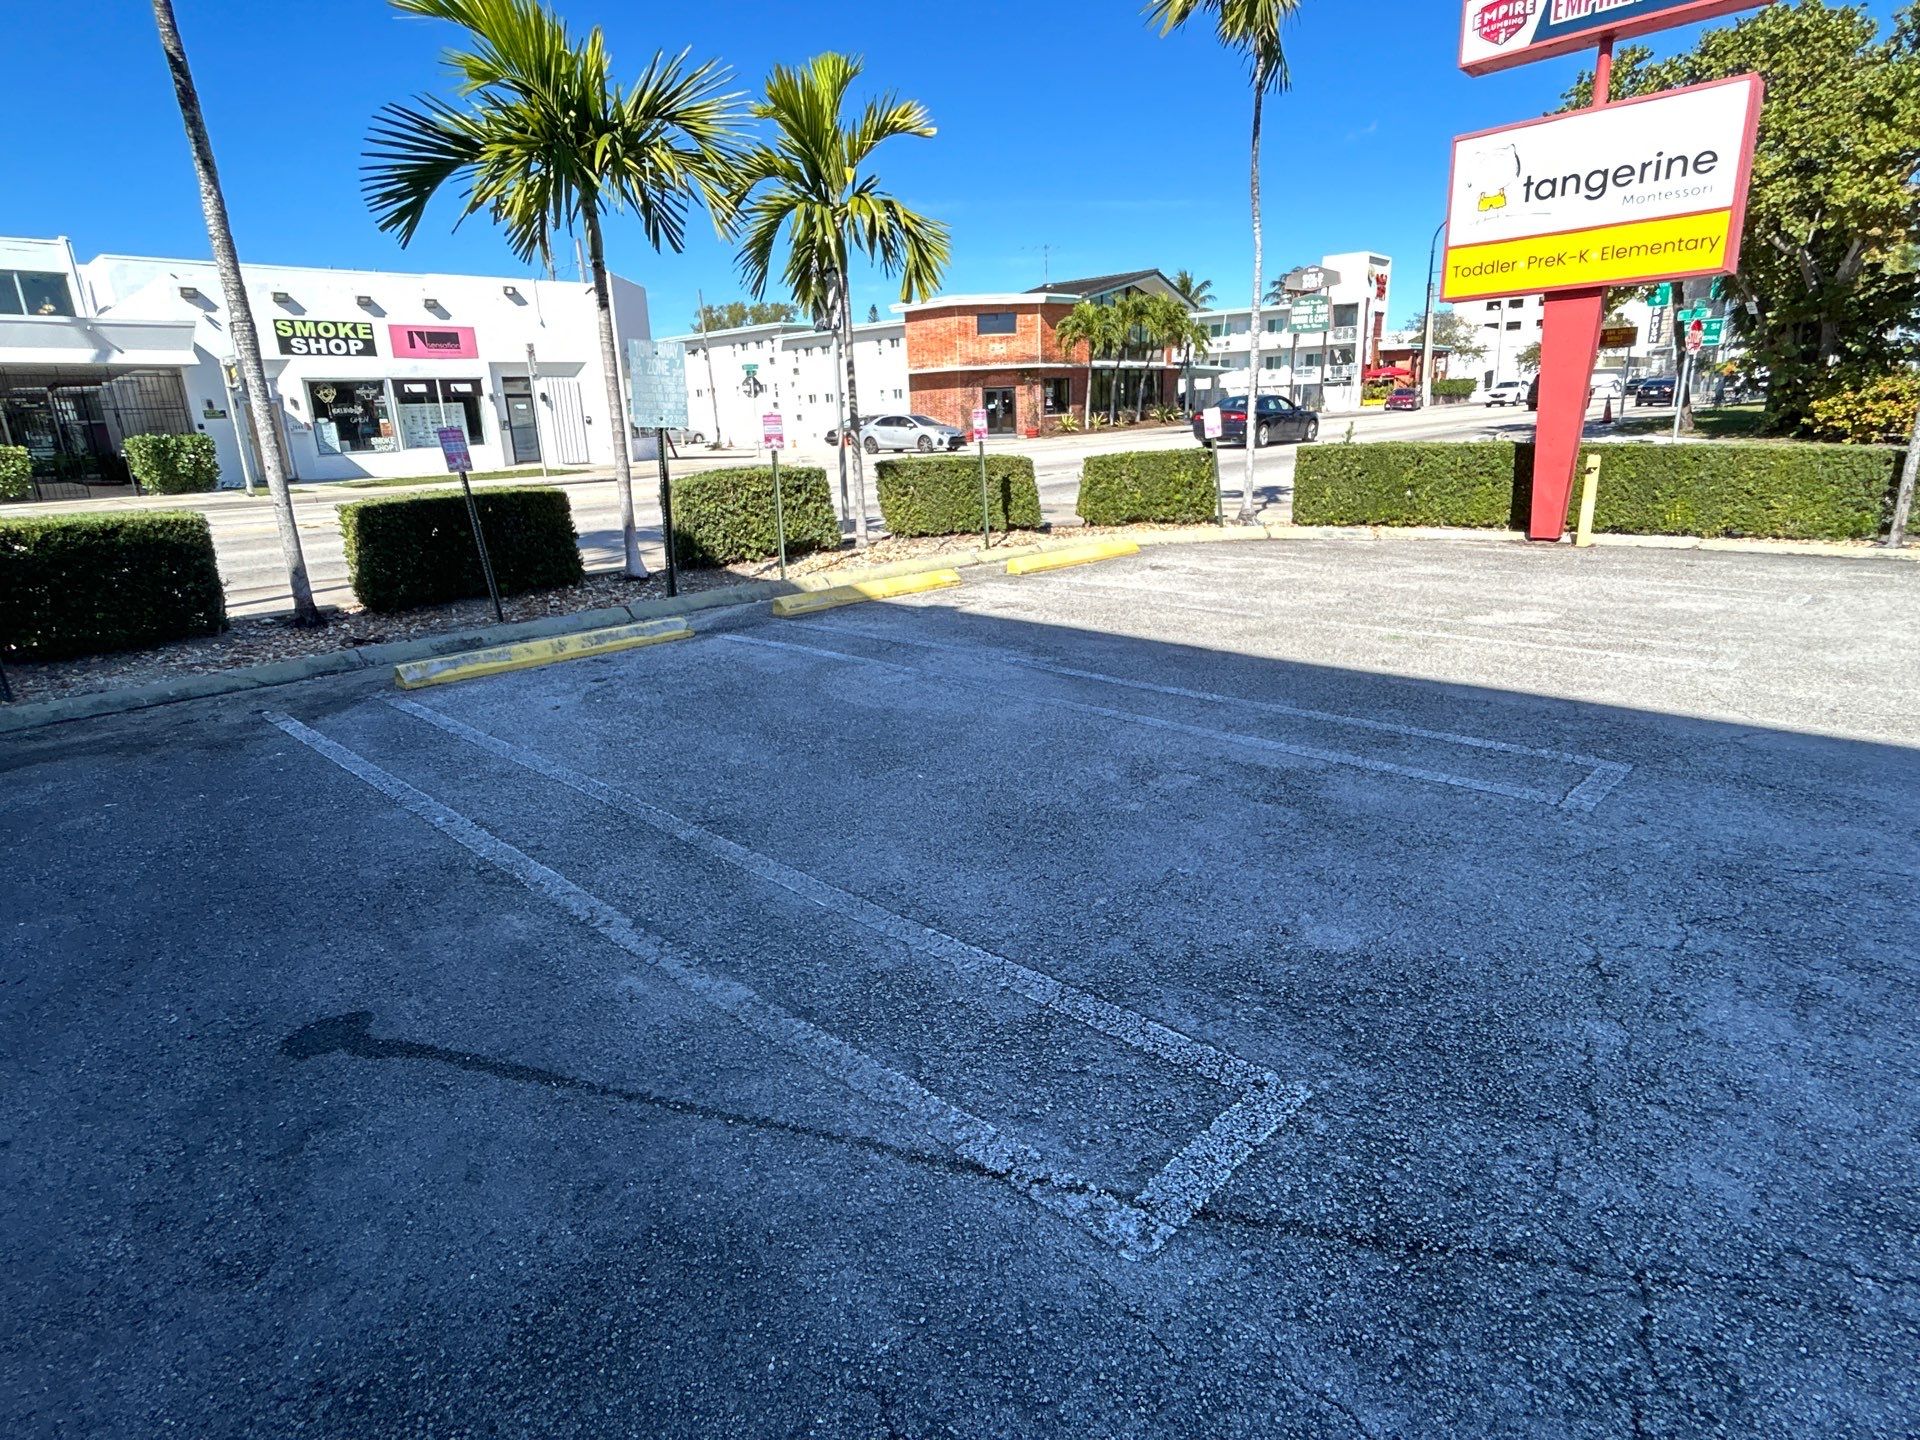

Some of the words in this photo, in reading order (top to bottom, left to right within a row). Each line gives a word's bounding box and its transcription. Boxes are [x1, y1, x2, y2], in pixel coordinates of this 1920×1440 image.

[1473, 0, 1536, 31] EMPIRE
[1482, 16, 1524, 34] PLUMBING
[1523, 149, 1719, 203] tangerine
[1622, 184, 1713, 206] Montessori
[1453, 257, 1517, 279] Toddler
[1527, 248, 1592, 271] PreK-K
[1600, 234, 1722, 264] Elementary
[275, 320, 373, 340] SMOKE
[290, 338, 364, 356] SHOP
